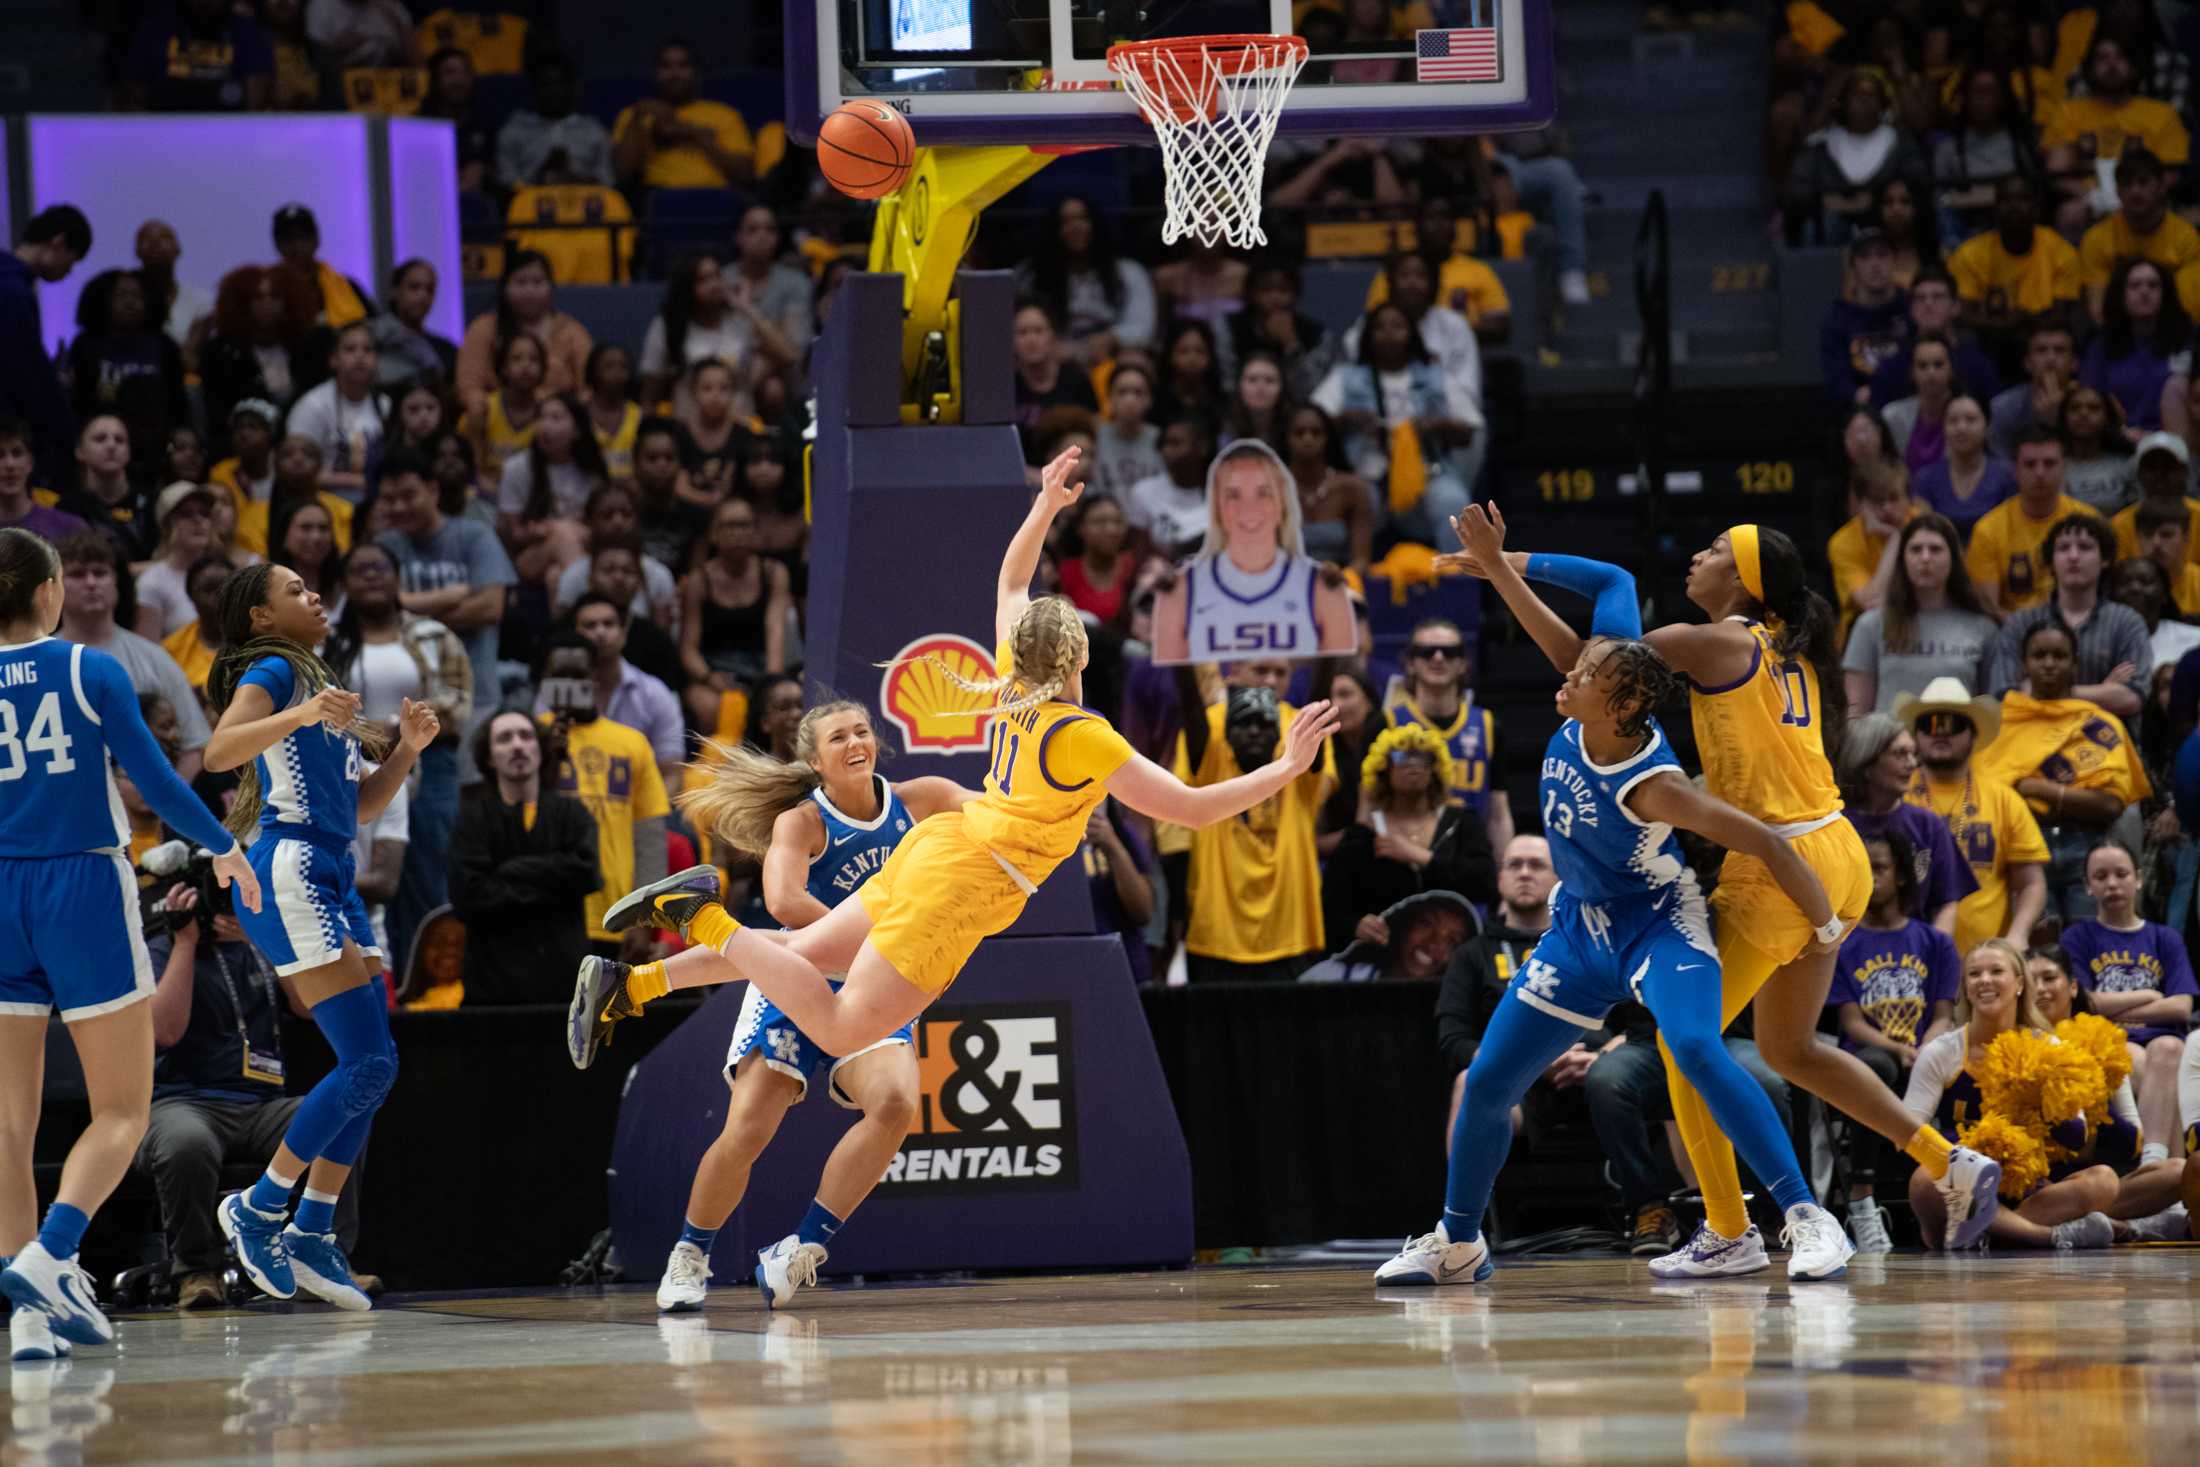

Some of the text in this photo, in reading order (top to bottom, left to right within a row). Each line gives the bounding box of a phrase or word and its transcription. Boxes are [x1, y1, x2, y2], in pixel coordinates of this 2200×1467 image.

[1537, 468, 1595, 502] 119
[1736, 461, 1794, 493] 120
[1206, 623, 1295, 652] LSU
[993, 720, 1020, 798] 11
[1543, 757, 1599, 829] KENTUCKY
[1543, 789, 1574, 839] 13
[1524, 958, 1561, 1000] UK
[1854, 951, 1929, 983] BALL KID
[2089, 950, 2164, 981] BALL KID
[766, 1027, 800, 1066] UK
[908, 1017, 1062, 1134] H&E
[881, 1144, 1062, 1182] RENTALS
